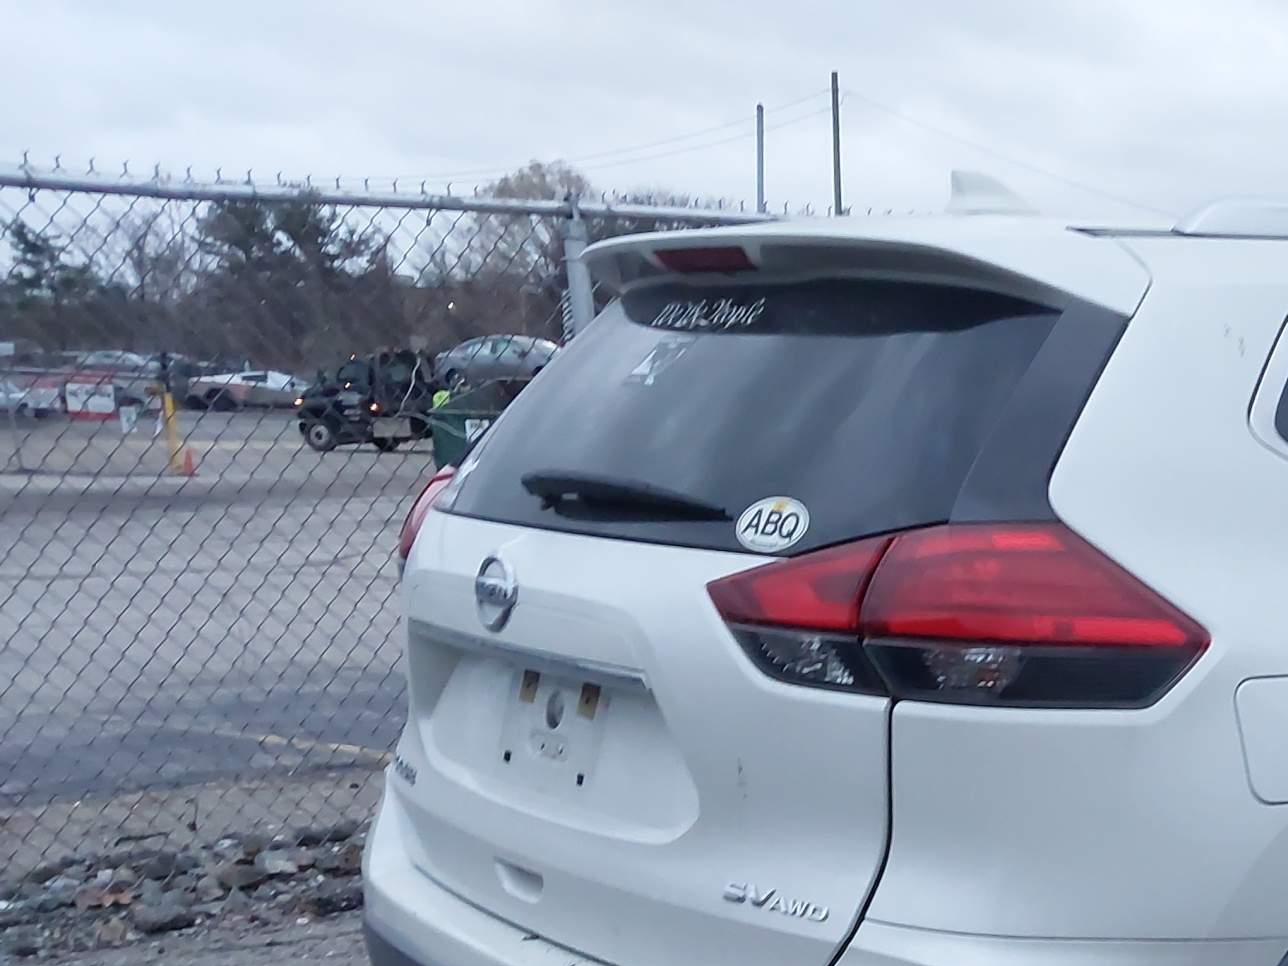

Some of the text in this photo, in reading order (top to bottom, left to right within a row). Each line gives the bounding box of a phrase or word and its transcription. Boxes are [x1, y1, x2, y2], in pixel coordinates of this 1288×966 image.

[741, 507, 801, 543] ABQ
[723, 881, 830, 922] SV AWD
